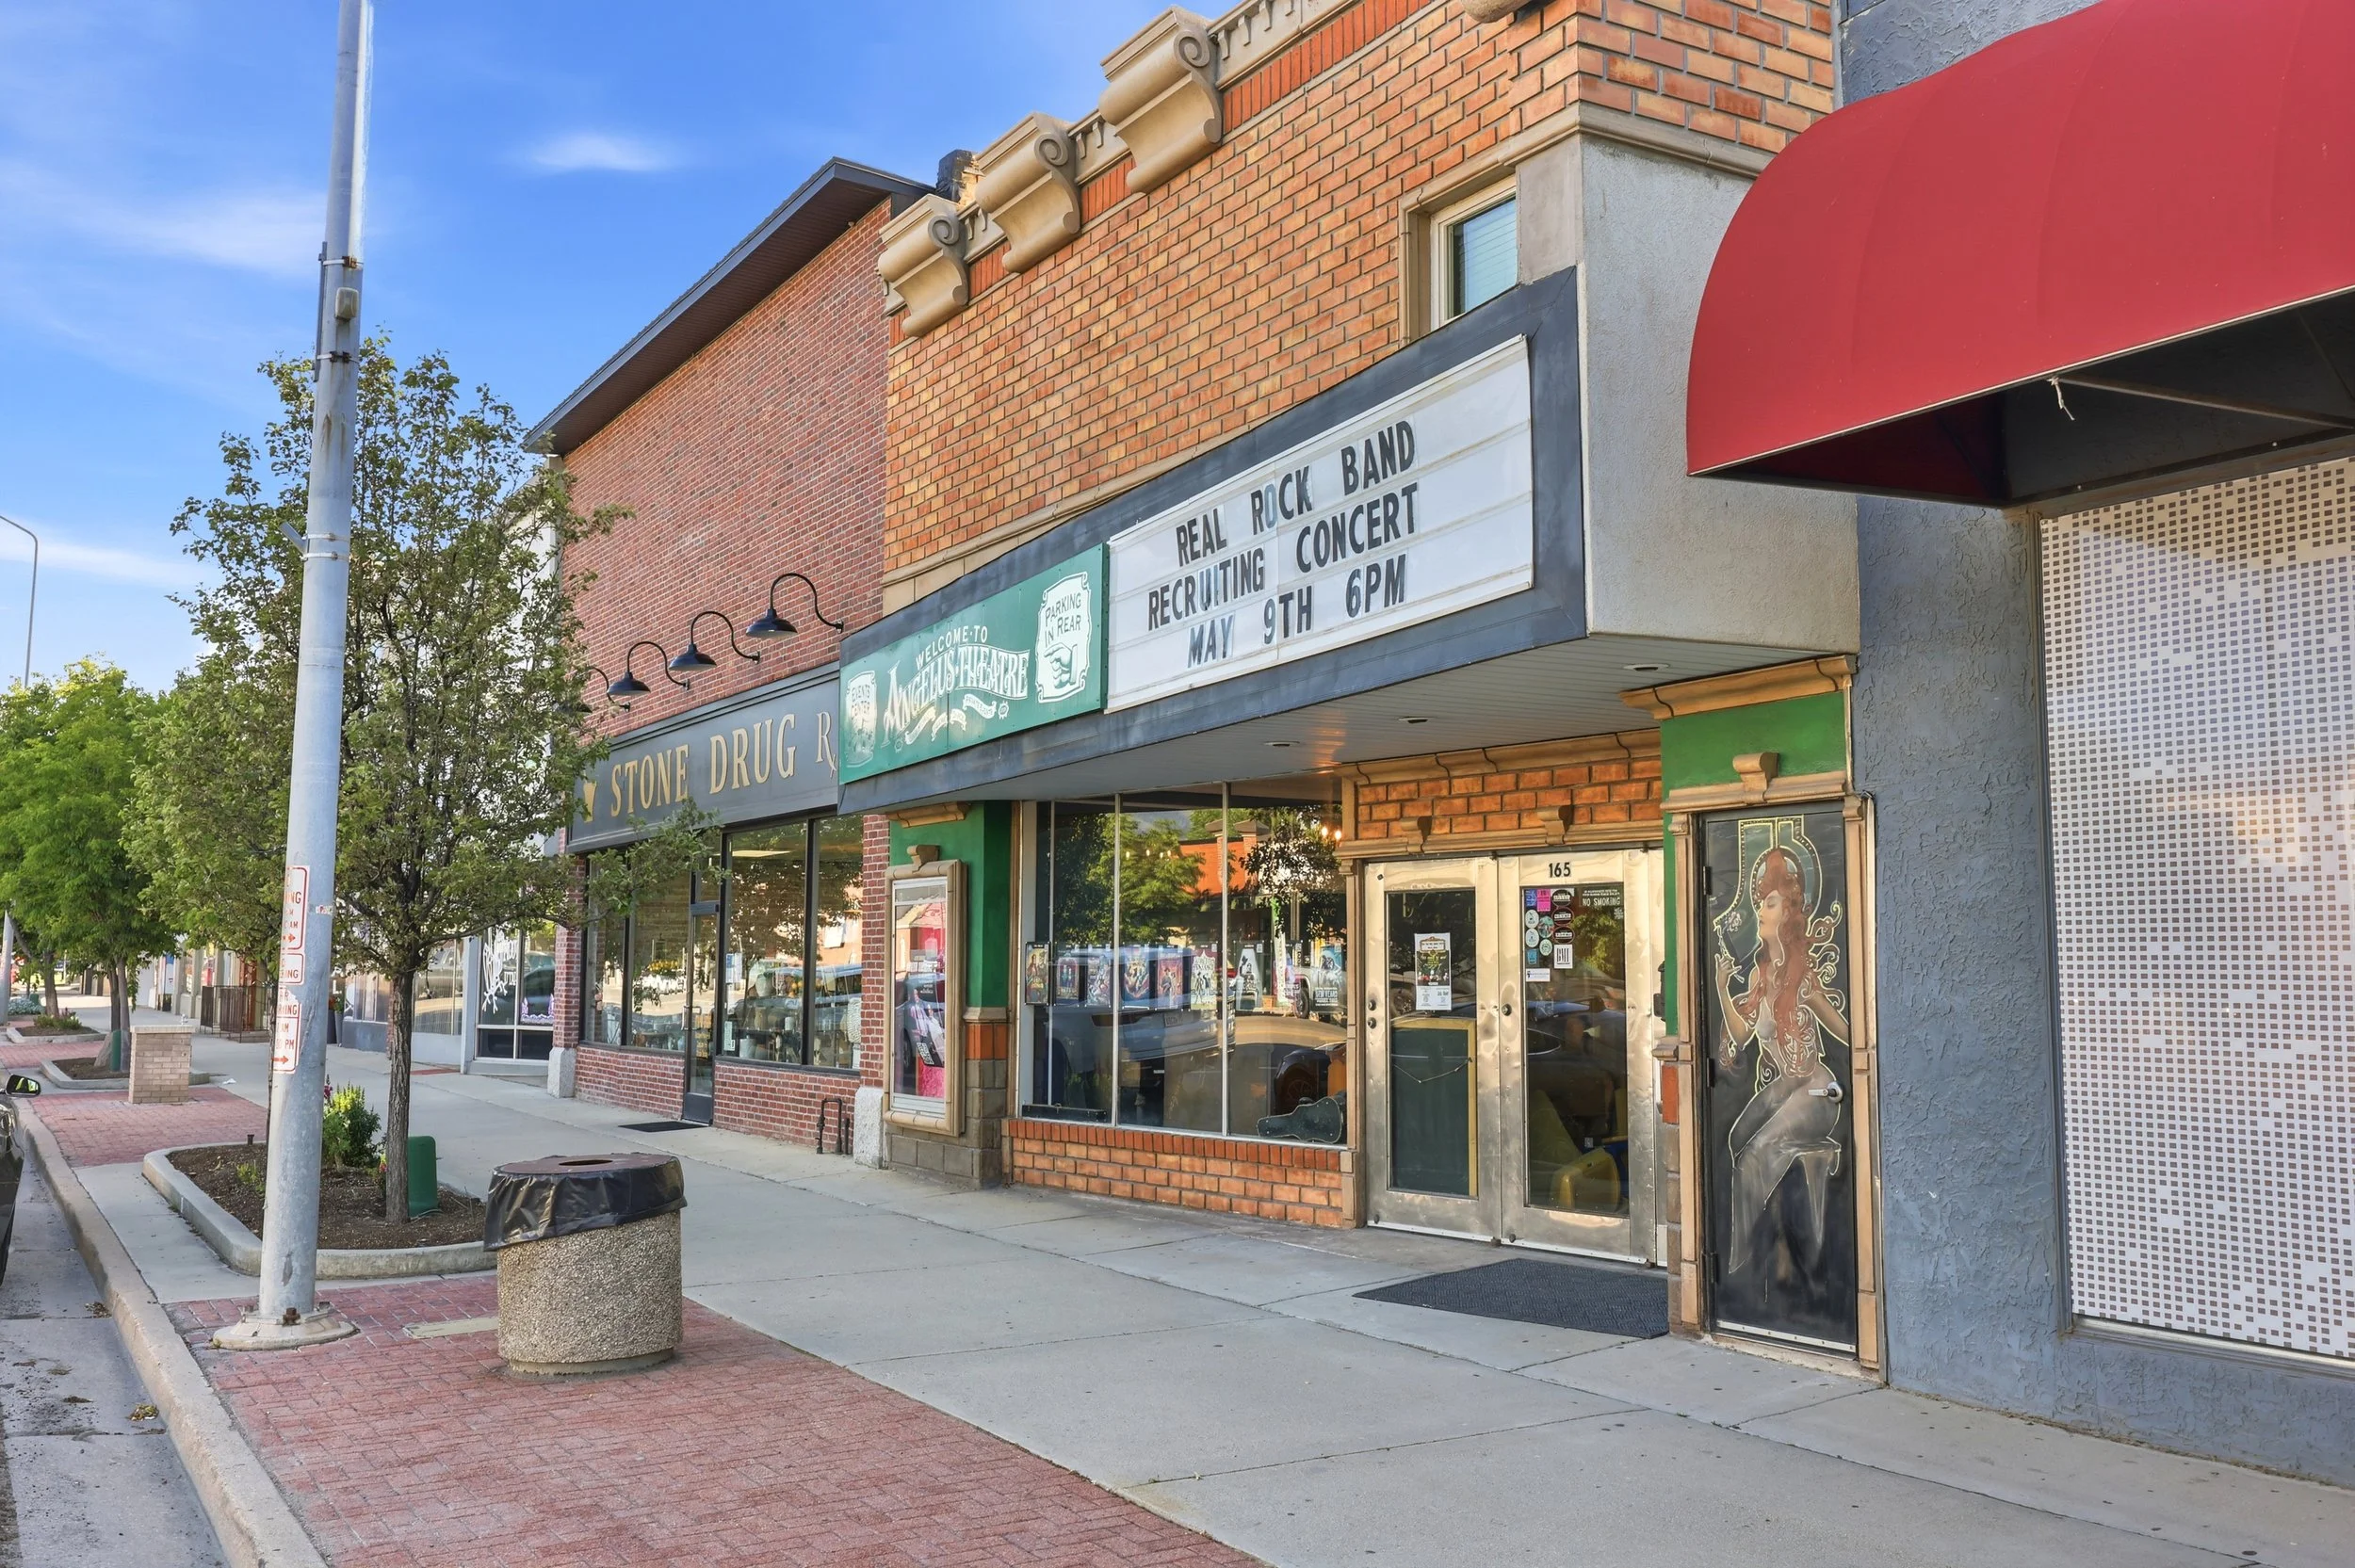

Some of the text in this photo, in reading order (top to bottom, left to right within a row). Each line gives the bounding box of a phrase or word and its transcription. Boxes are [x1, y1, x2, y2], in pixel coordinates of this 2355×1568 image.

[1176, 420, 1415, 567] REAL ROCK BAND
[1148, 482, 1418, 631] RECRUITING CONCERT
[1045, 592, 1082, 628] PARKING
[1045, 614, 1081, 644] IN REAR
[1187, 554, 1408, 670] MAY 9TH 6PM
[957, 646, 1031, 700] THEATRE
[610, 744, 690, 817] STONE
[709, 714, 796, 795] DRUG
[1549, 862, 1571, 878] 165
[1583, 897, 1620, 907] NO SMOKING
